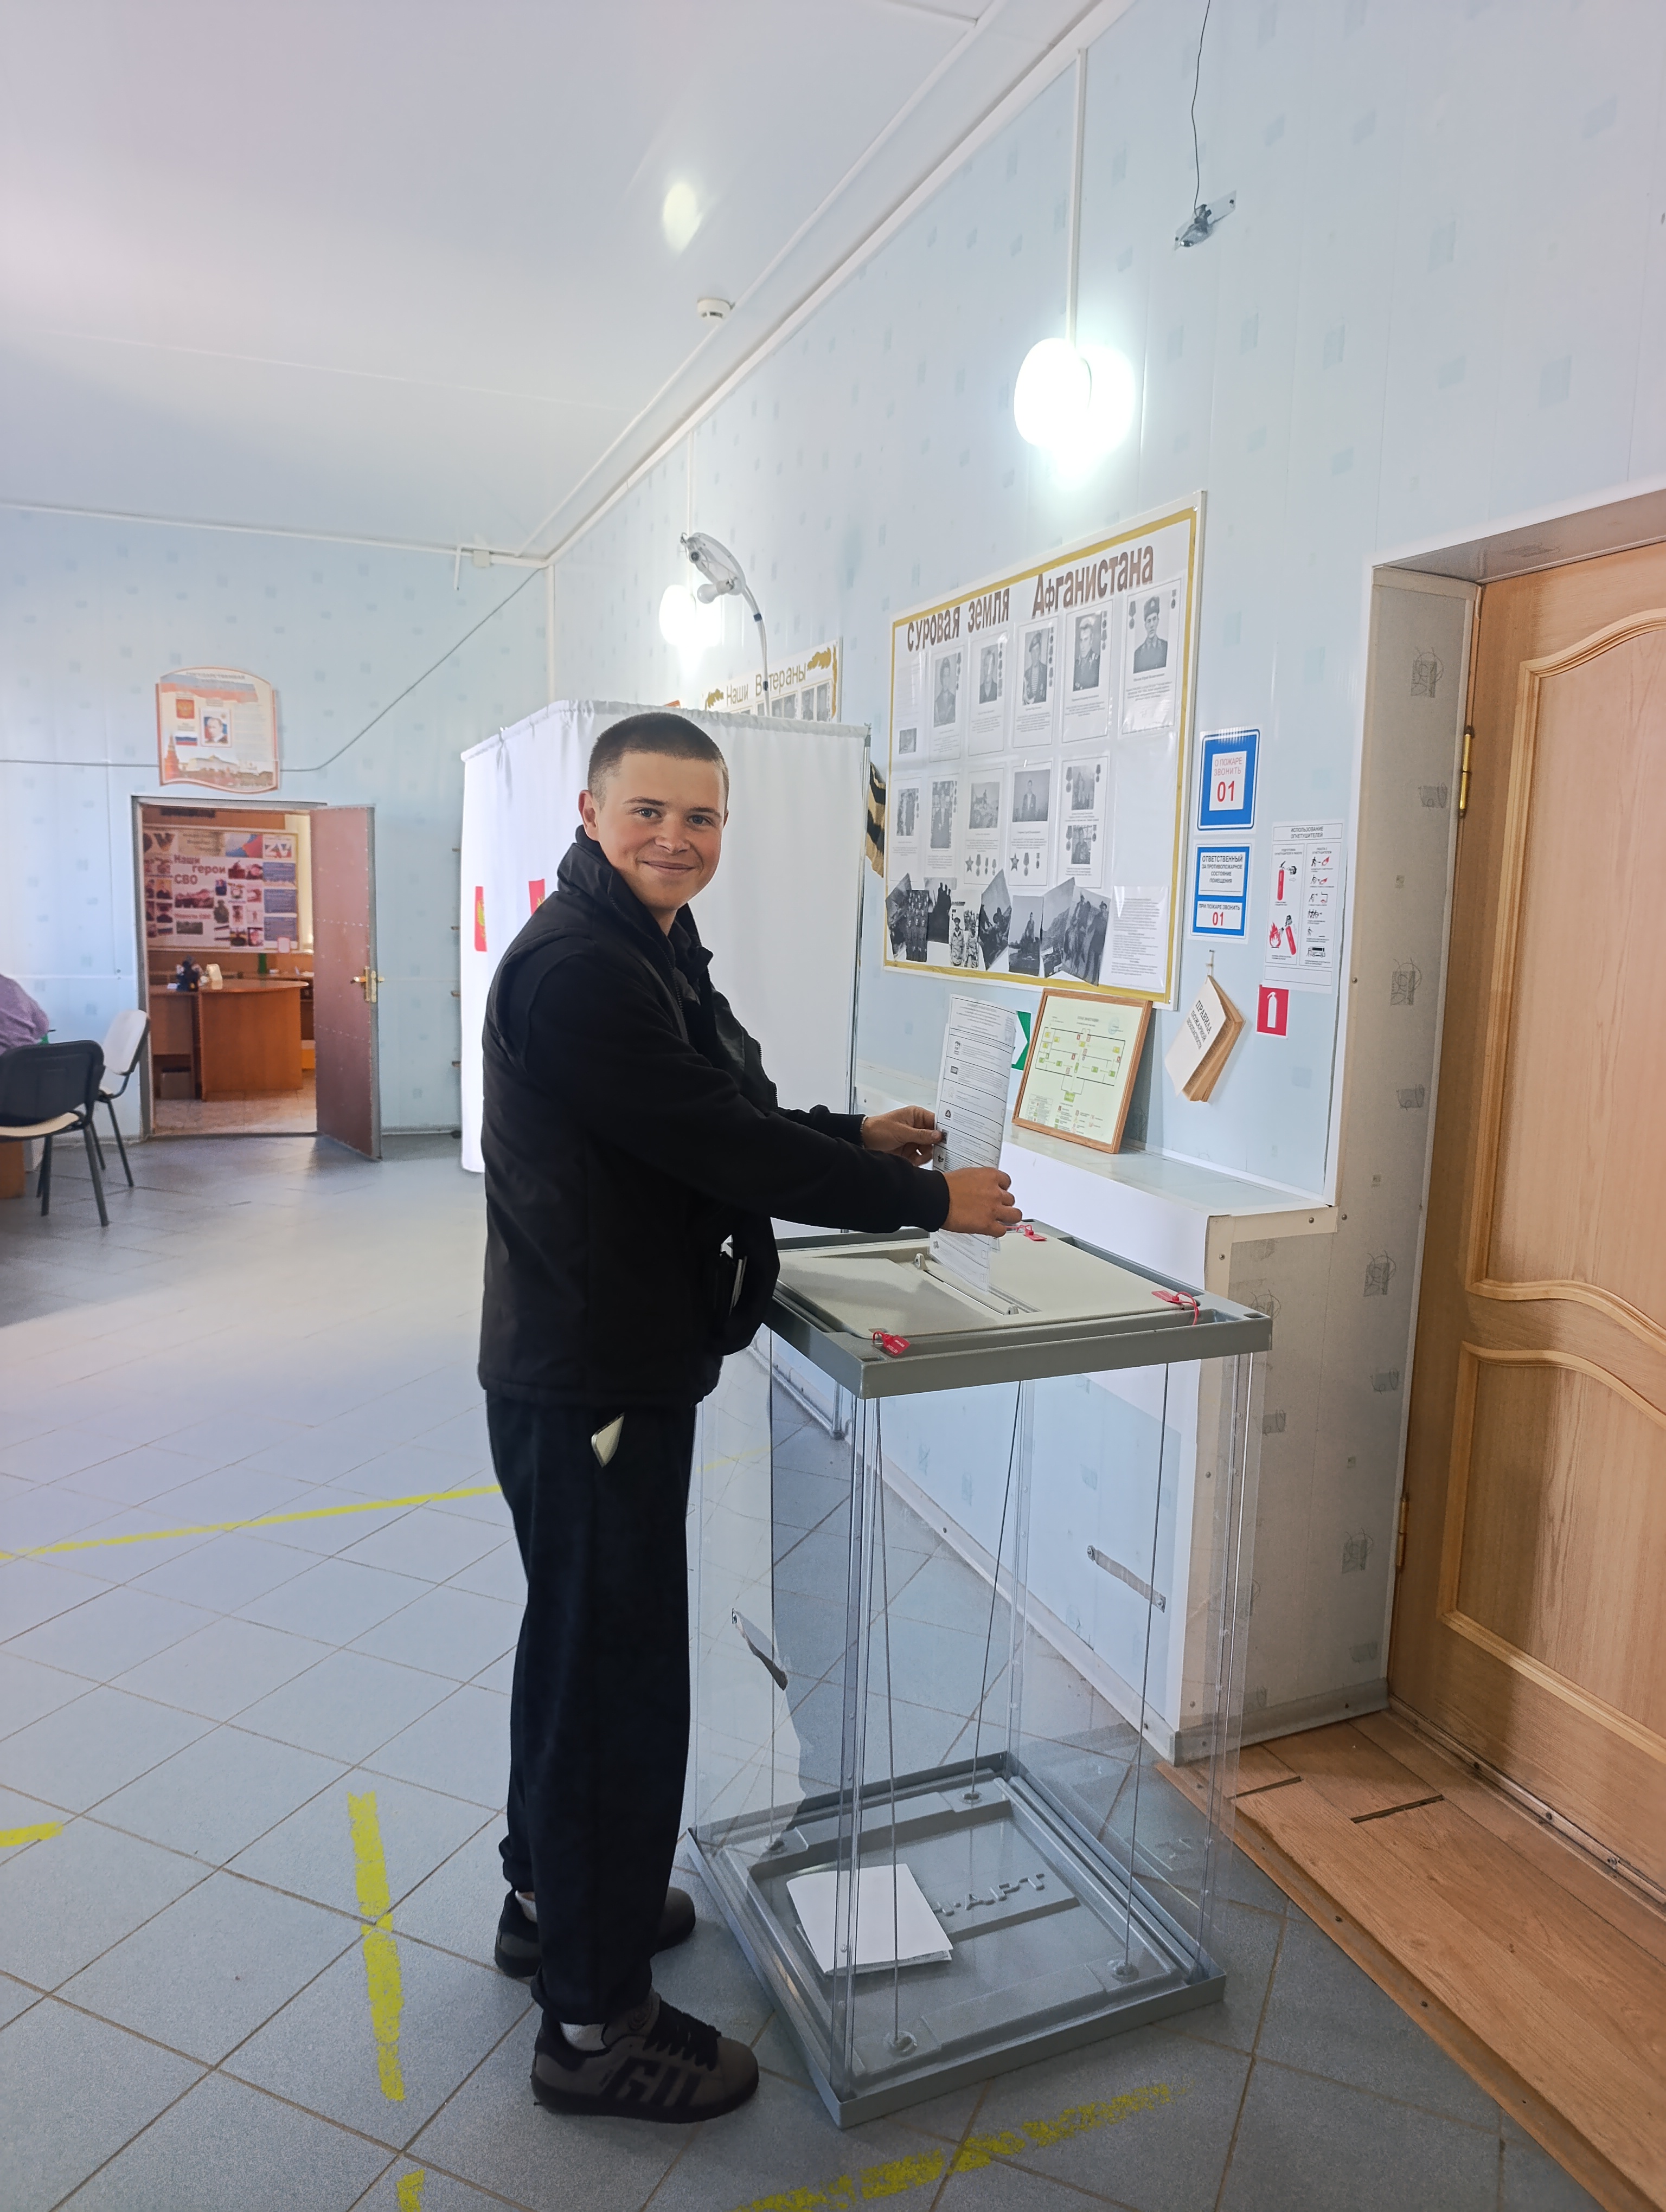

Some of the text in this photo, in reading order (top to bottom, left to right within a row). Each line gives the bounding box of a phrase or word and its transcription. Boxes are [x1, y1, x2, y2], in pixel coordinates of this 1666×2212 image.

[907, 545, 1154, 652] суровая земля Афганистана
[727, 663, 806, 706] Наши Втераны
[1220, 757, 1242, 766] ПОЖАРЕ
[1214, 767, 1241, 776] ЗВОНИТЬ
[1217, 780, 1234, 802] 01
[174, 874, 198, 885] СВО
[192, 865, 226, 876] герои
[1212, 911, 1223, 926] 01
[1195, 999, 1212, 1034] ПРАВИЛА
[1190, 1010, 1207, 1042] ПОЖАРНОЙ
